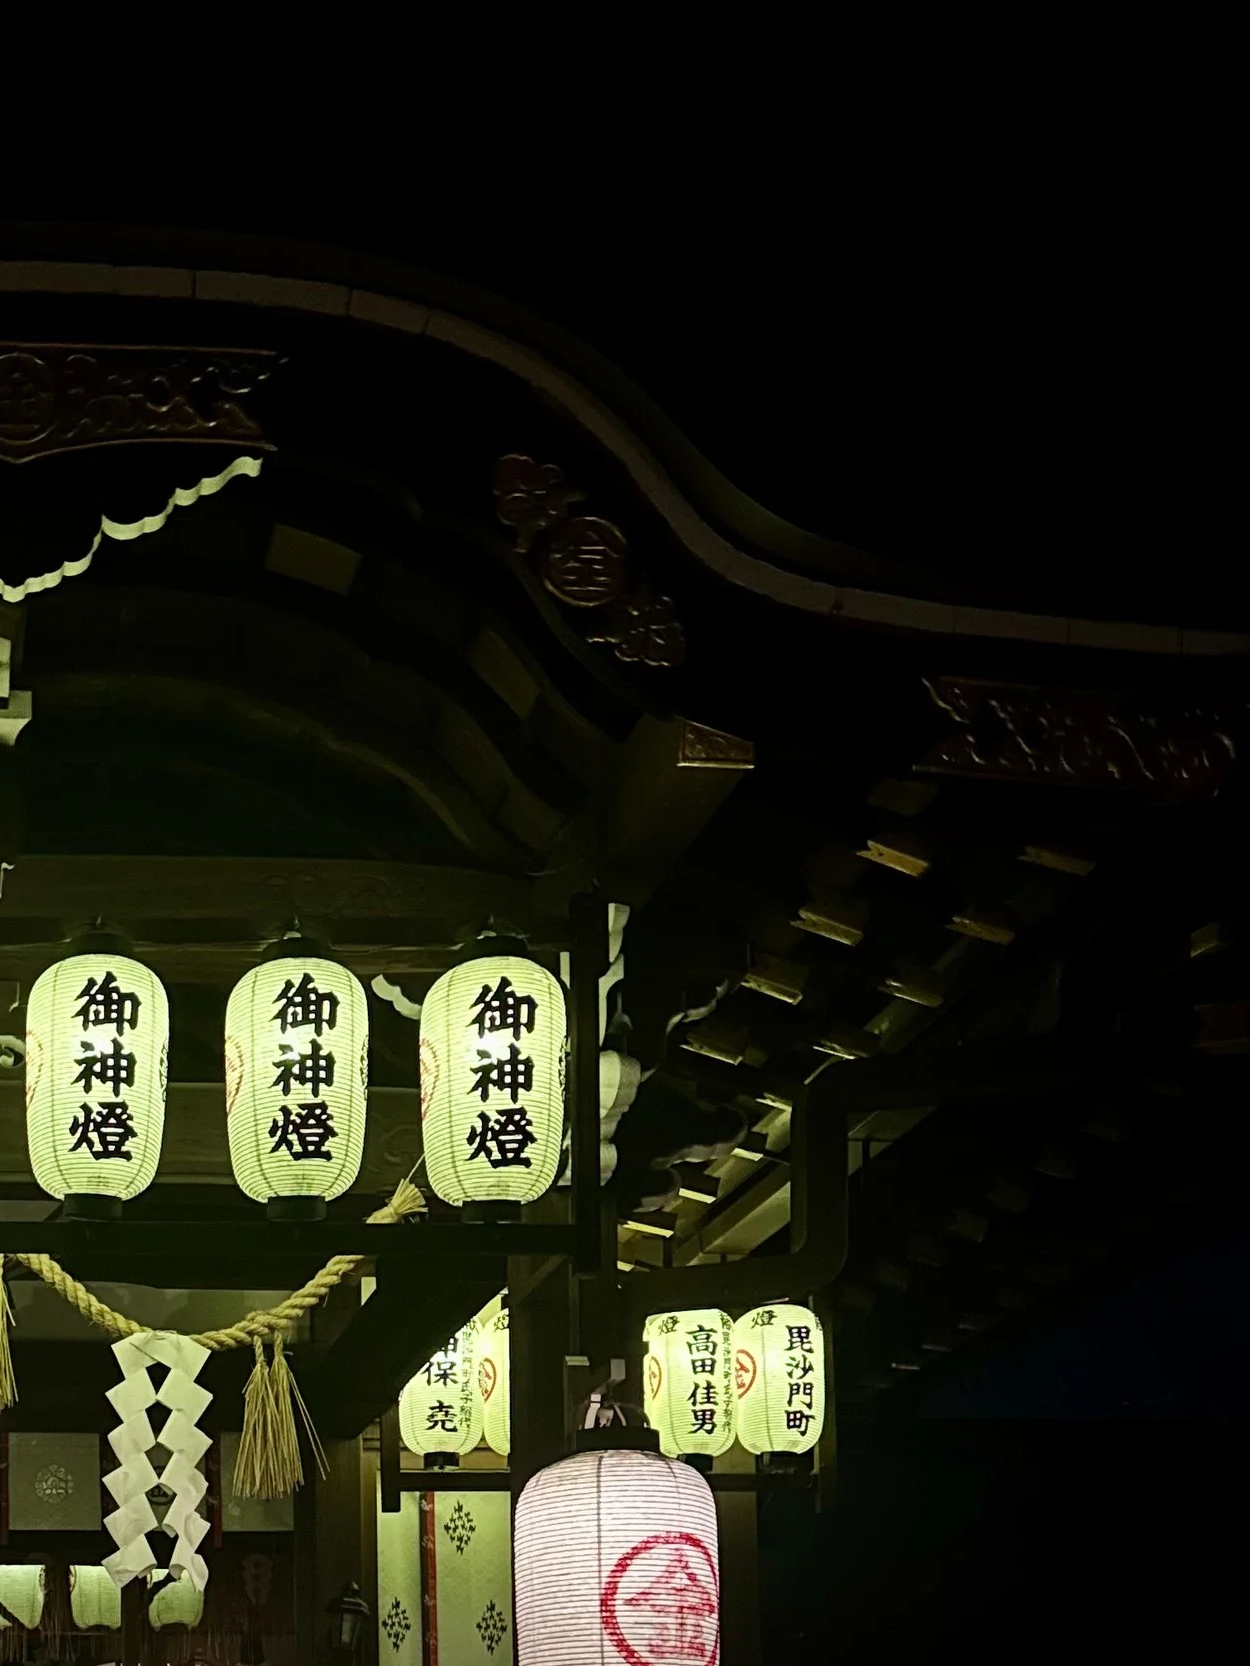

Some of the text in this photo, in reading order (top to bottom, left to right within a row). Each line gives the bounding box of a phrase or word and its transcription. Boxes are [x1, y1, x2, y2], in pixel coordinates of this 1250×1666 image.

[68, 970, 142, 1161] 御神燈
[267, 972, 340, 1162] 御神燈
[465, 975, 539, 1169] 御神燈
[685, 1324, 719, 1435] 高田佳男
[783, 1325, 816, 1437] 毘沙門町
